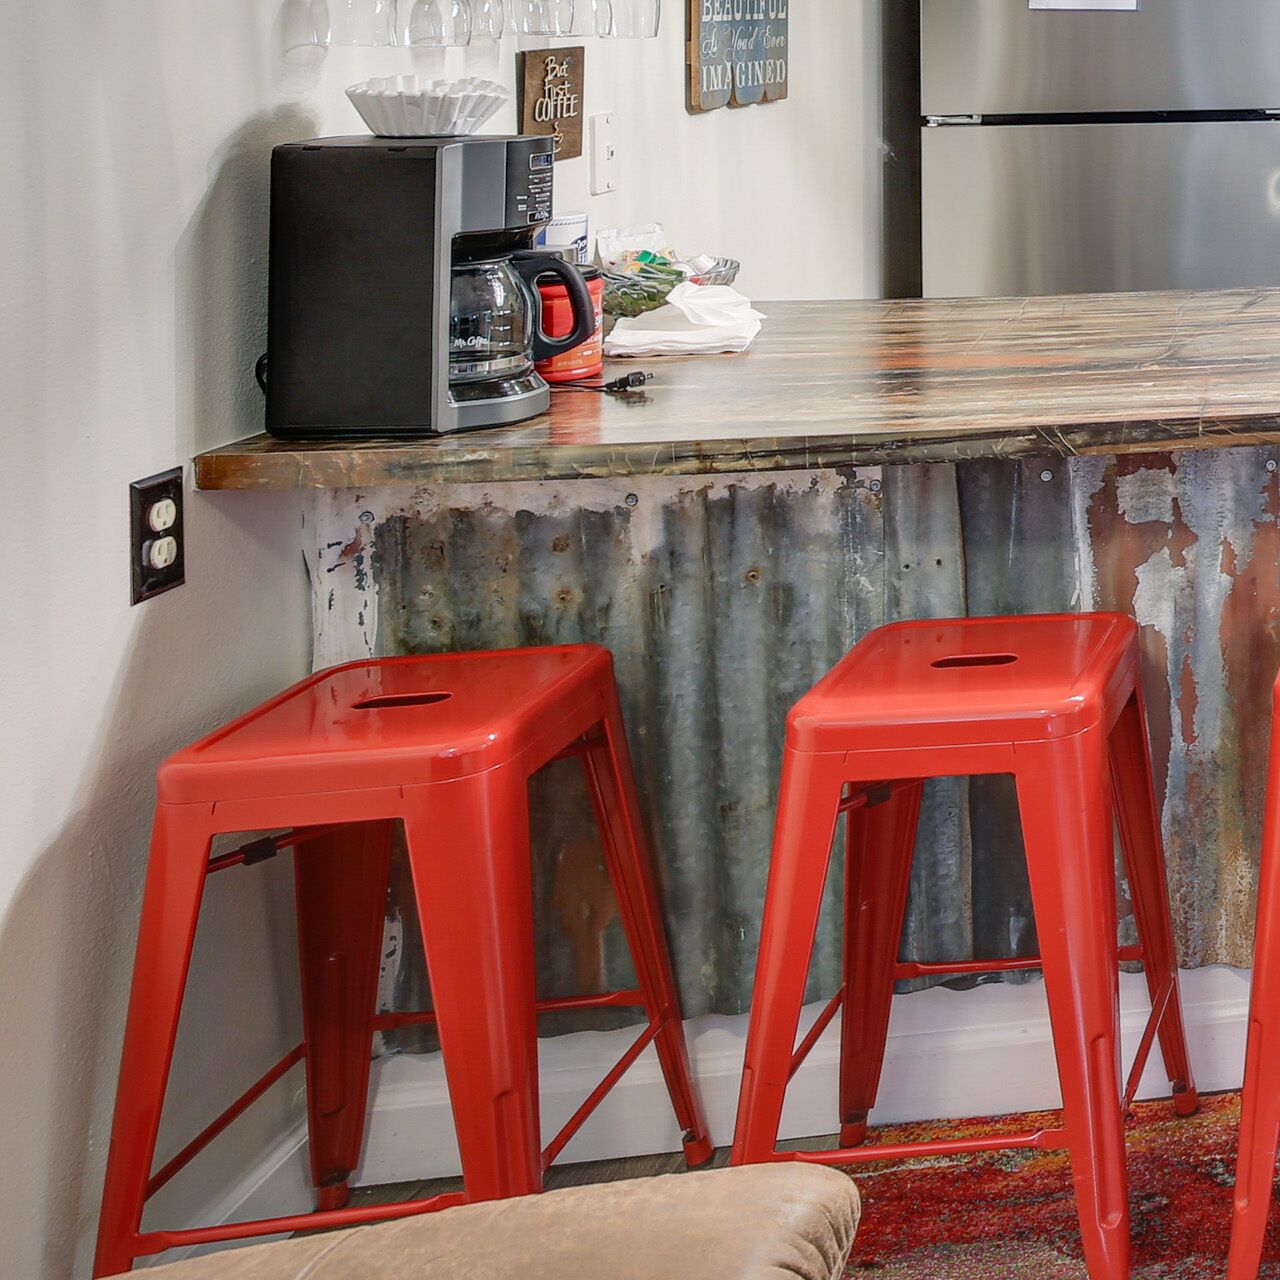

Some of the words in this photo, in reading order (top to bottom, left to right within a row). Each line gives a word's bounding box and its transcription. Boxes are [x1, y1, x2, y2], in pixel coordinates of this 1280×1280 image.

[545, 56, 568, 79] But
[702, 59, 786, 92] IMAGINED
[535, 94, 578, 121] COFFEE
